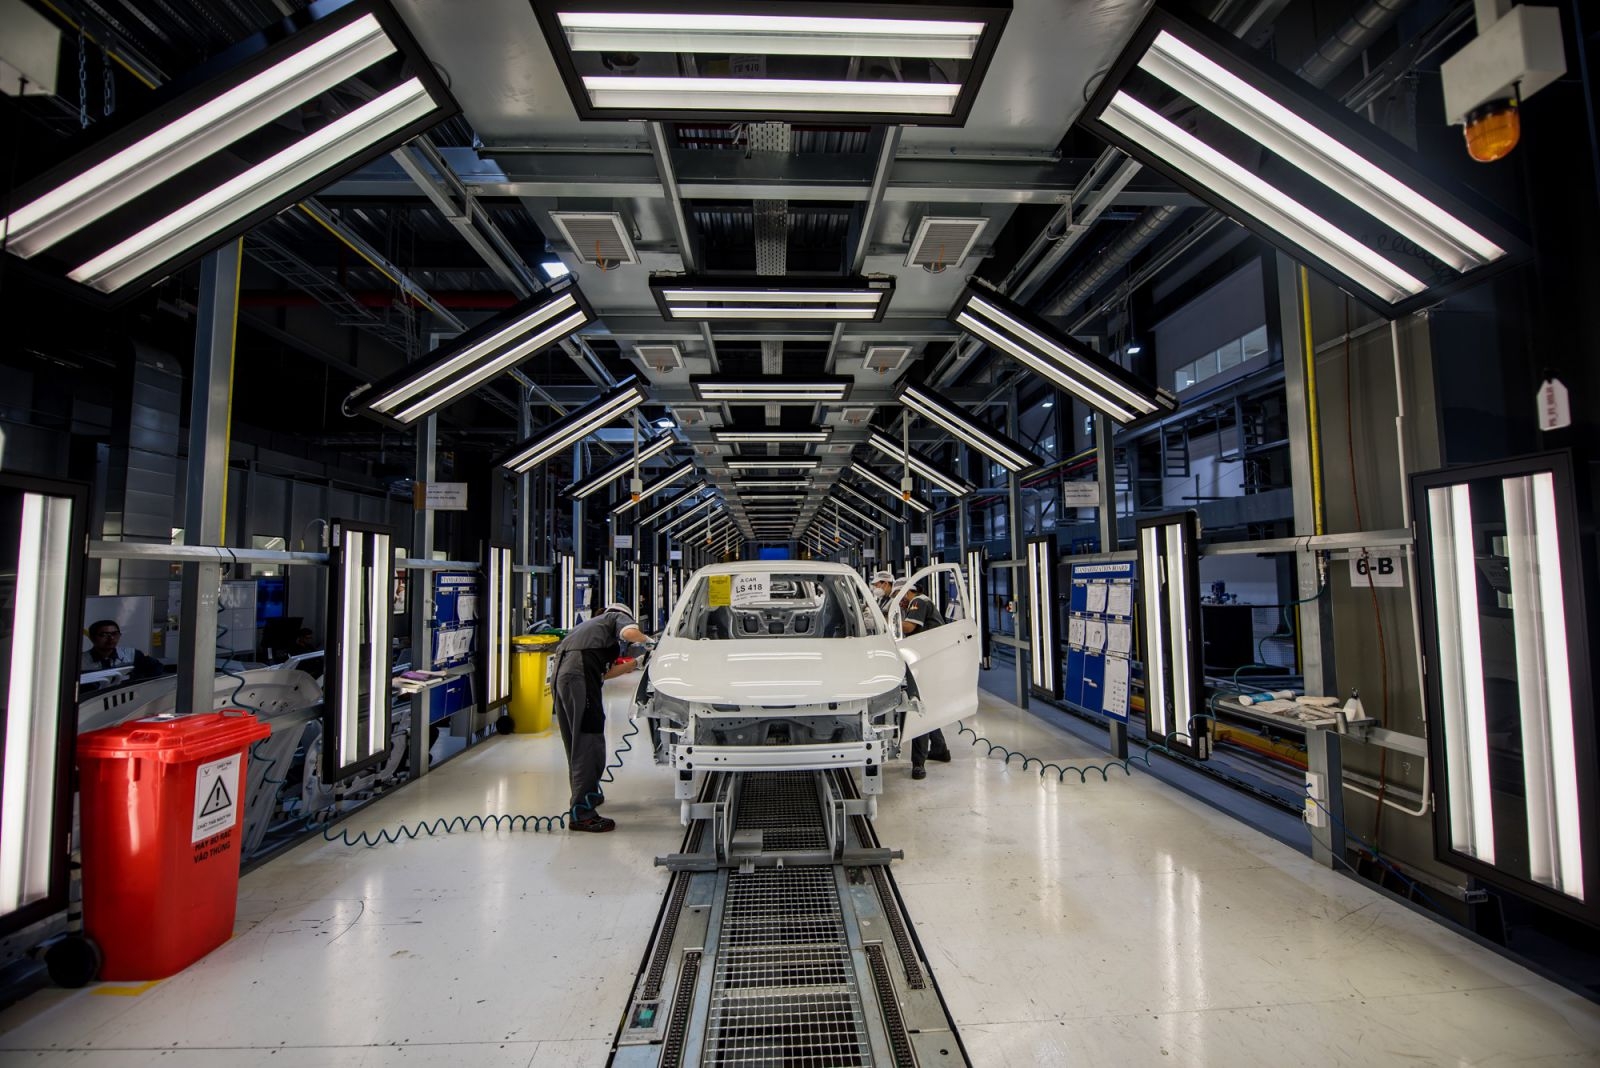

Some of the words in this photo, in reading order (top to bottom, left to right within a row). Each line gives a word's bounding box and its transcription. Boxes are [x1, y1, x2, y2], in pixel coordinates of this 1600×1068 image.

[1356, 557, 1394, 575] 6-B
[736, 585, 746, 593] LS
[748, 583, 763, 591] 418
